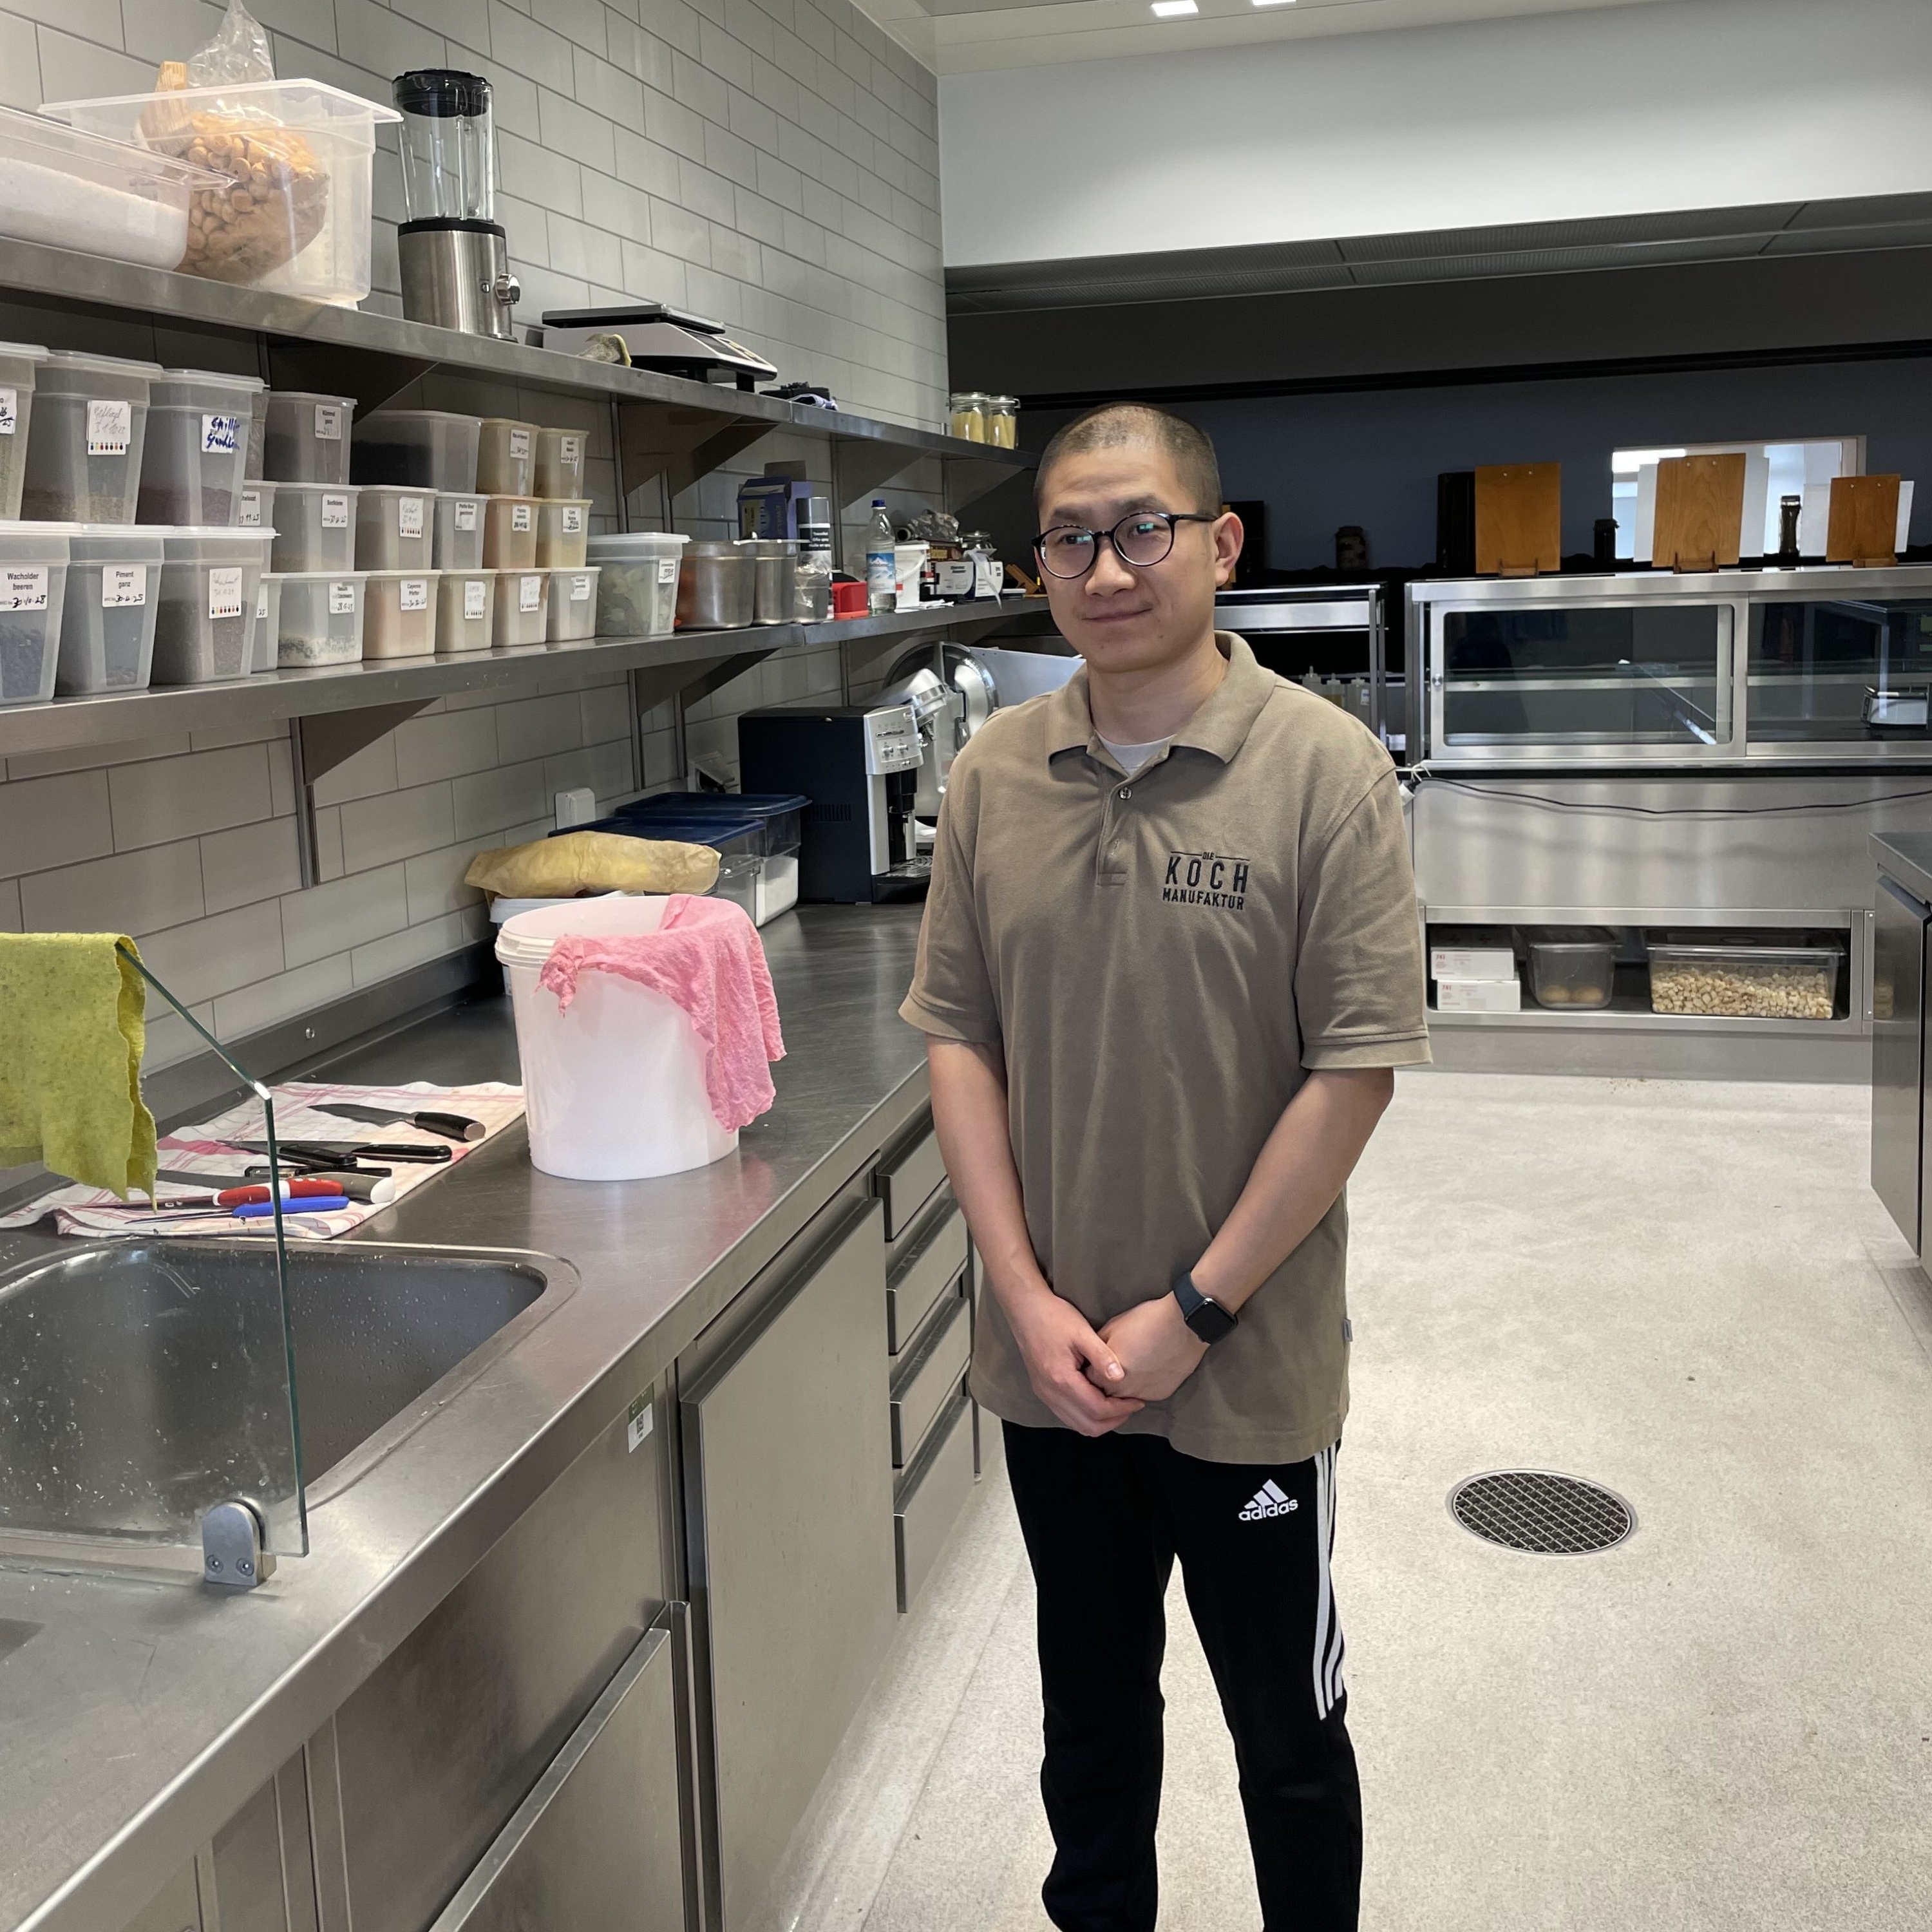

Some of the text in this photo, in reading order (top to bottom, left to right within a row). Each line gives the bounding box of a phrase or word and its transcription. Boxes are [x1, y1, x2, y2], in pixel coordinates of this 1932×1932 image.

[1202, 851, 1215, 860] DIE
[1165, 856, 1249, 893] KOCH
[1162, 887, 1245, 911] MANUFAKTUR
[1238, 1499, 1298, 1520] adidas
